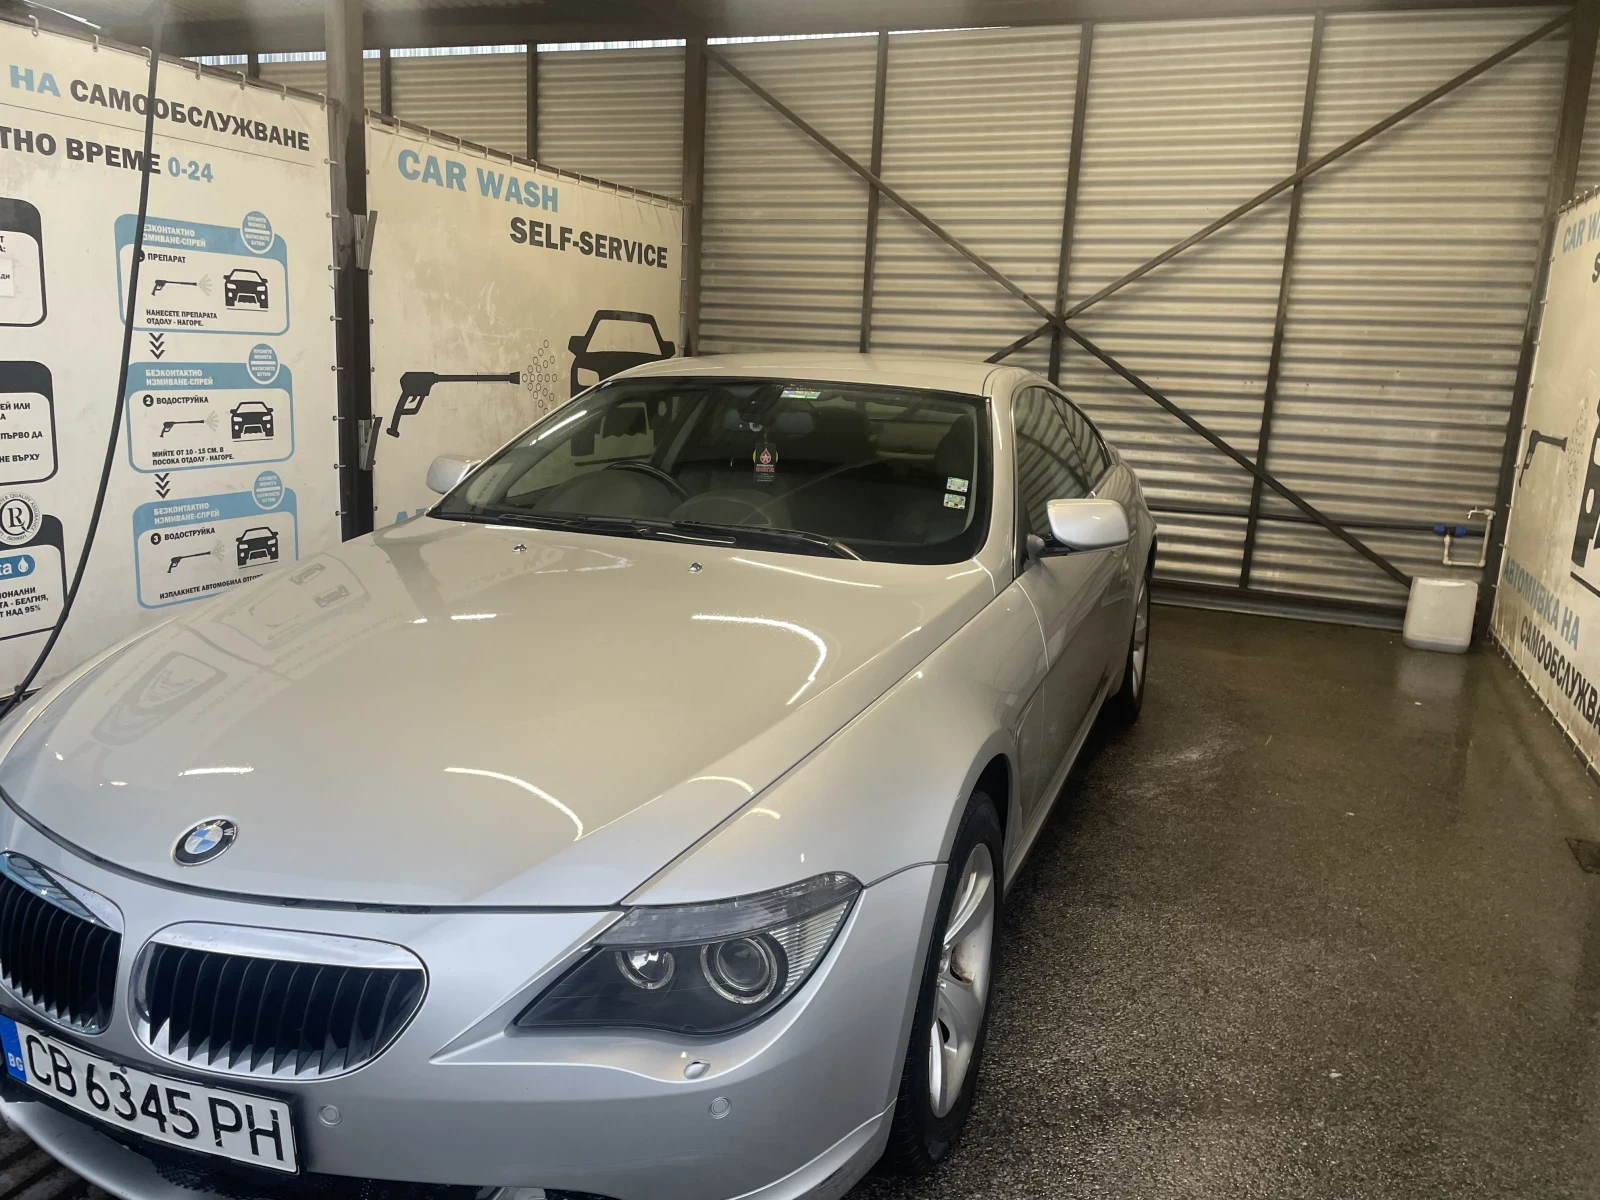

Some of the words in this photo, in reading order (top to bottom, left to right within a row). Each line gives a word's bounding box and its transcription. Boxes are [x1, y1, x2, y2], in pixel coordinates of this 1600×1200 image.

[9, 64, 60, 97] НА
[70, 79, 310, 151] САМООБСЛУЖВАНЕ
[66, 137, 161, 174] ВРЕМЕ
[167, 156, 214, 183] 0-24
[397, 149, 467, 192] CAR
[476, 167, 558, 212] WASH
[143, 223, 195, 237] ЕЗКОНТАКТНО
[1562, 218, 1587, 253] CAR
[142, 233, 206, 247] ЗМИВАНЕ-СПРЕЙ
[510, 216, 668, 269] SELF-SERVICE
[147, 252, 186, 263] ПРЕПАРАТ
[146, 309, 180, 318] НАНЕСЕТЕ
[181, 311, 218, 319] ПРЕПАРАТА
[146, 317, 173, 326] ОТДОЛУ
[145, 369, 203, 377] БЕЗКОНТАКТНО
[146, 377, 213, 386] ИЗМИВАНЕ-СПРЕЙ
[14, 402, 30, 410] ИЛИ
[156, 394, 209, 405] ВОДОСТРУЙКА
[31, 431, 43, 439] ДА
[12, 453, 40, 462] ВЪРХУ
[152, 449, 175, 458] МИЙТЕ
[152, 458, 180, 466] ПОСОКА
[181, 456, 205, 464] ОТДОЛУ
[153, 502, 210, 516] БЕЗКОНТАКТНО
[154, 509, 220, 525] ИЗМИВАНЕ-СПРЕЙ
[164, 527, 216, 541] ВОДОСТРУЙКА
[159, 586, 200, 600] ИЗПЛАКНЕТЕ
[201, 578, 242, 592] АВТОМОБИЛА
[1502, 555, 1560, 631] АВТОМИВКА
[1560, 606, 1580, 651] НА
[6, 608, 23, 617] НАД
[8, 1052, 24, 1071] BG
[86, 1062, 200, 1140] 6345
